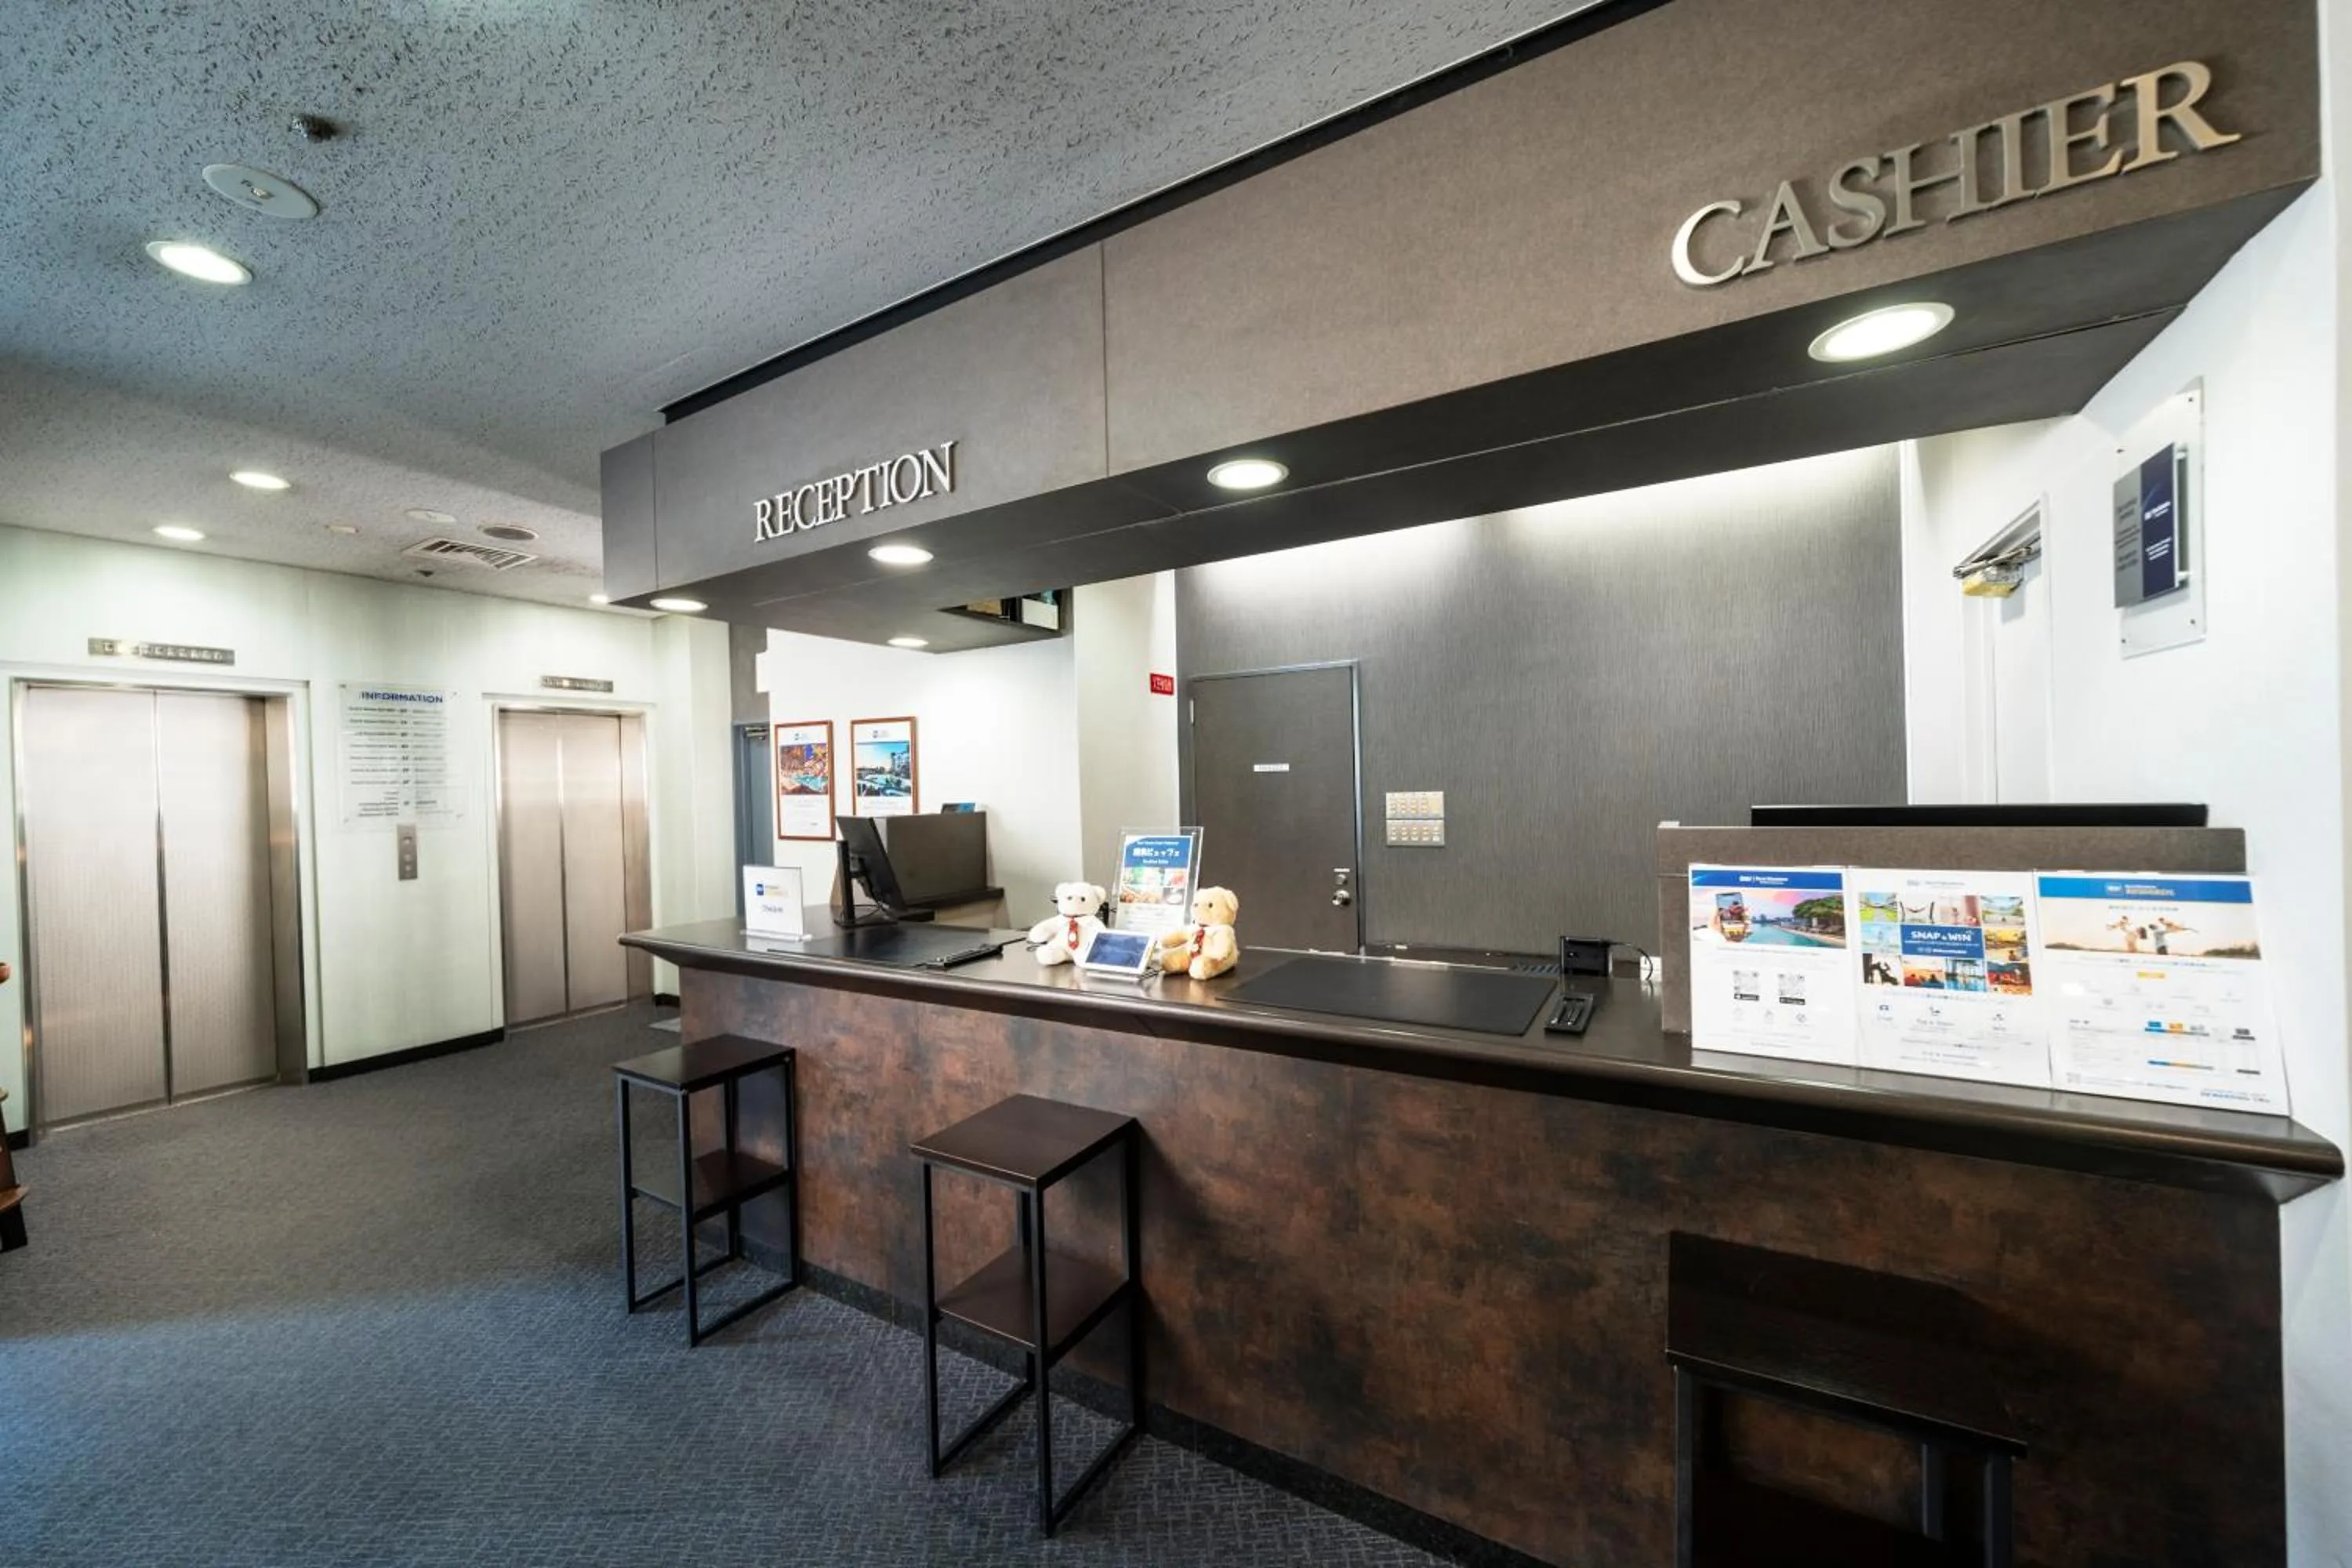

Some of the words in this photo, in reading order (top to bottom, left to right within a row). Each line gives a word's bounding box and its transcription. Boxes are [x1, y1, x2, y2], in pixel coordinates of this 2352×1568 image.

[1670, 60, 2242, 287] CASHIER
[753, 440, 956, 543] RECEPTION
[361, 691, 444, 704] INFORMATION
[1911, 931, 1941, 941] SNAP
[1947, 933, 1972, 942] WIN
